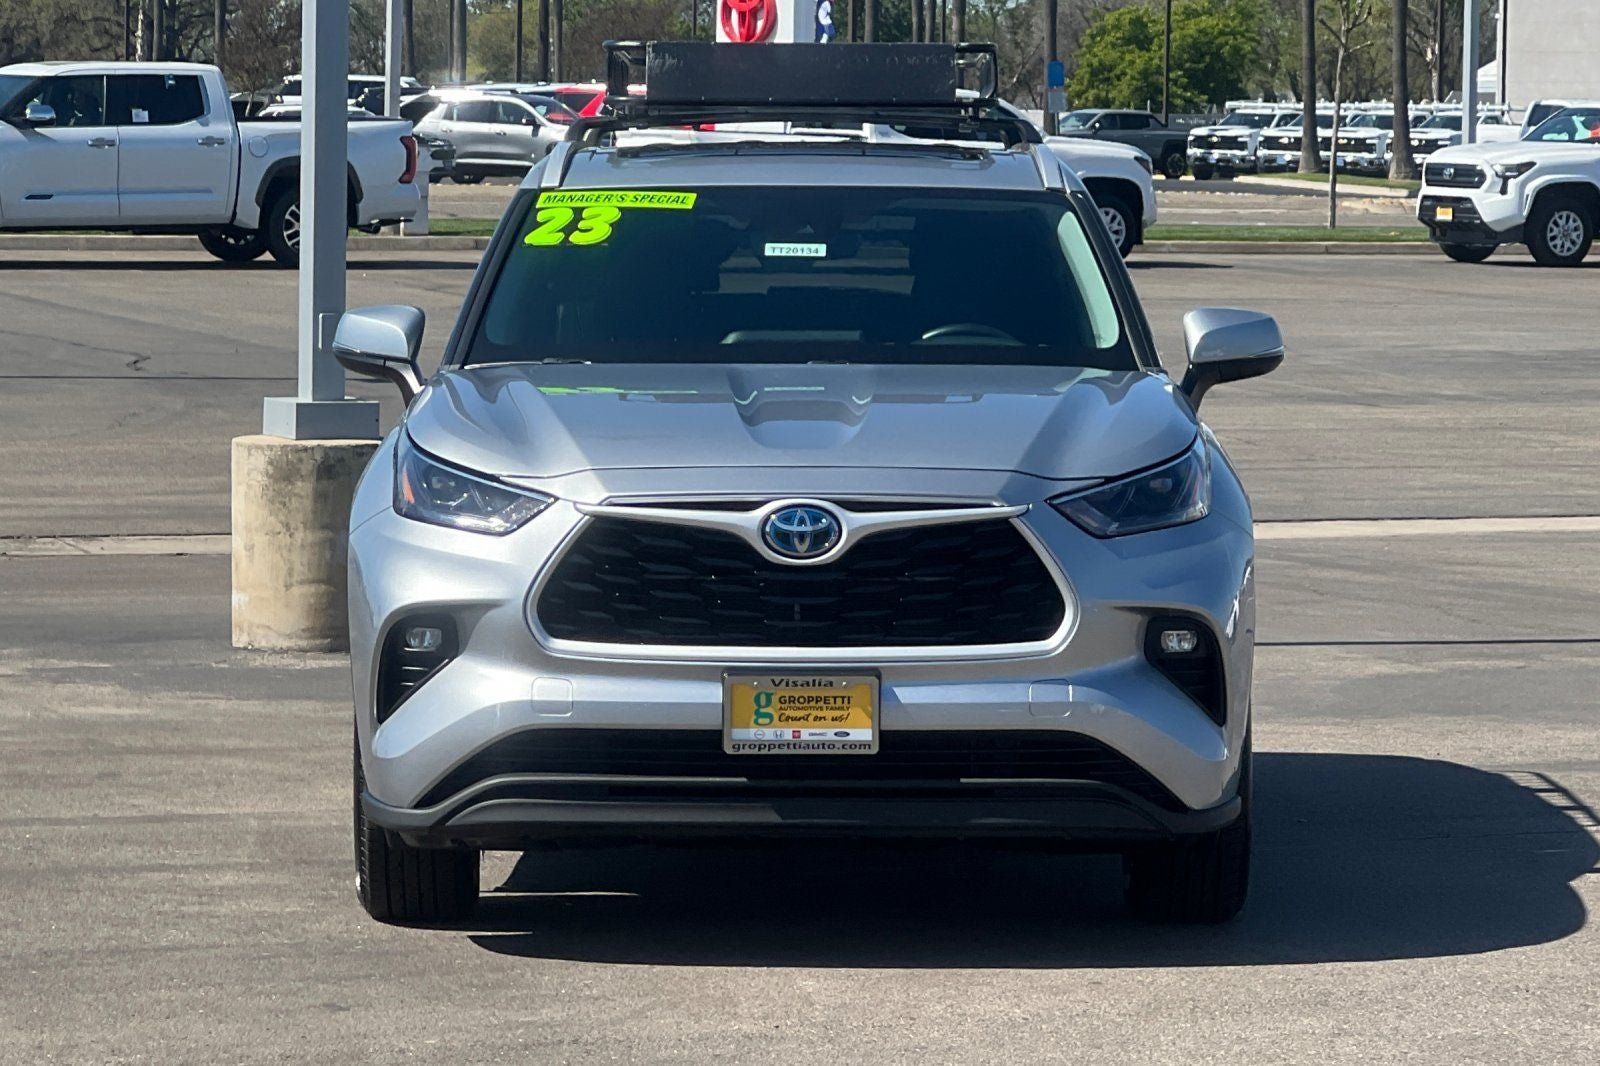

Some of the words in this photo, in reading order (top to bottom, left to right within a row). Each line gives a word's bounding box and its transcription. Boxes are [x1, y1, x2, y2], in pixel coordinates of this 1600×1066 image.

[543, 193, 627, 204] MANAGER'S
[629, 194, 689, 205] SPECIAL
[524, 206, 622, 246] 23
[770, 246, 819, 255] TT20134
[770, 678, 834, 688] Visalia
[778, 695, 852, 705] GROPPETTI
[778, 712, 812, 723] Count
[813, 714, 827, 722] on
[830, 712, 851, 723] us!
[732, 741, 872, 753] groppettiauto.com
